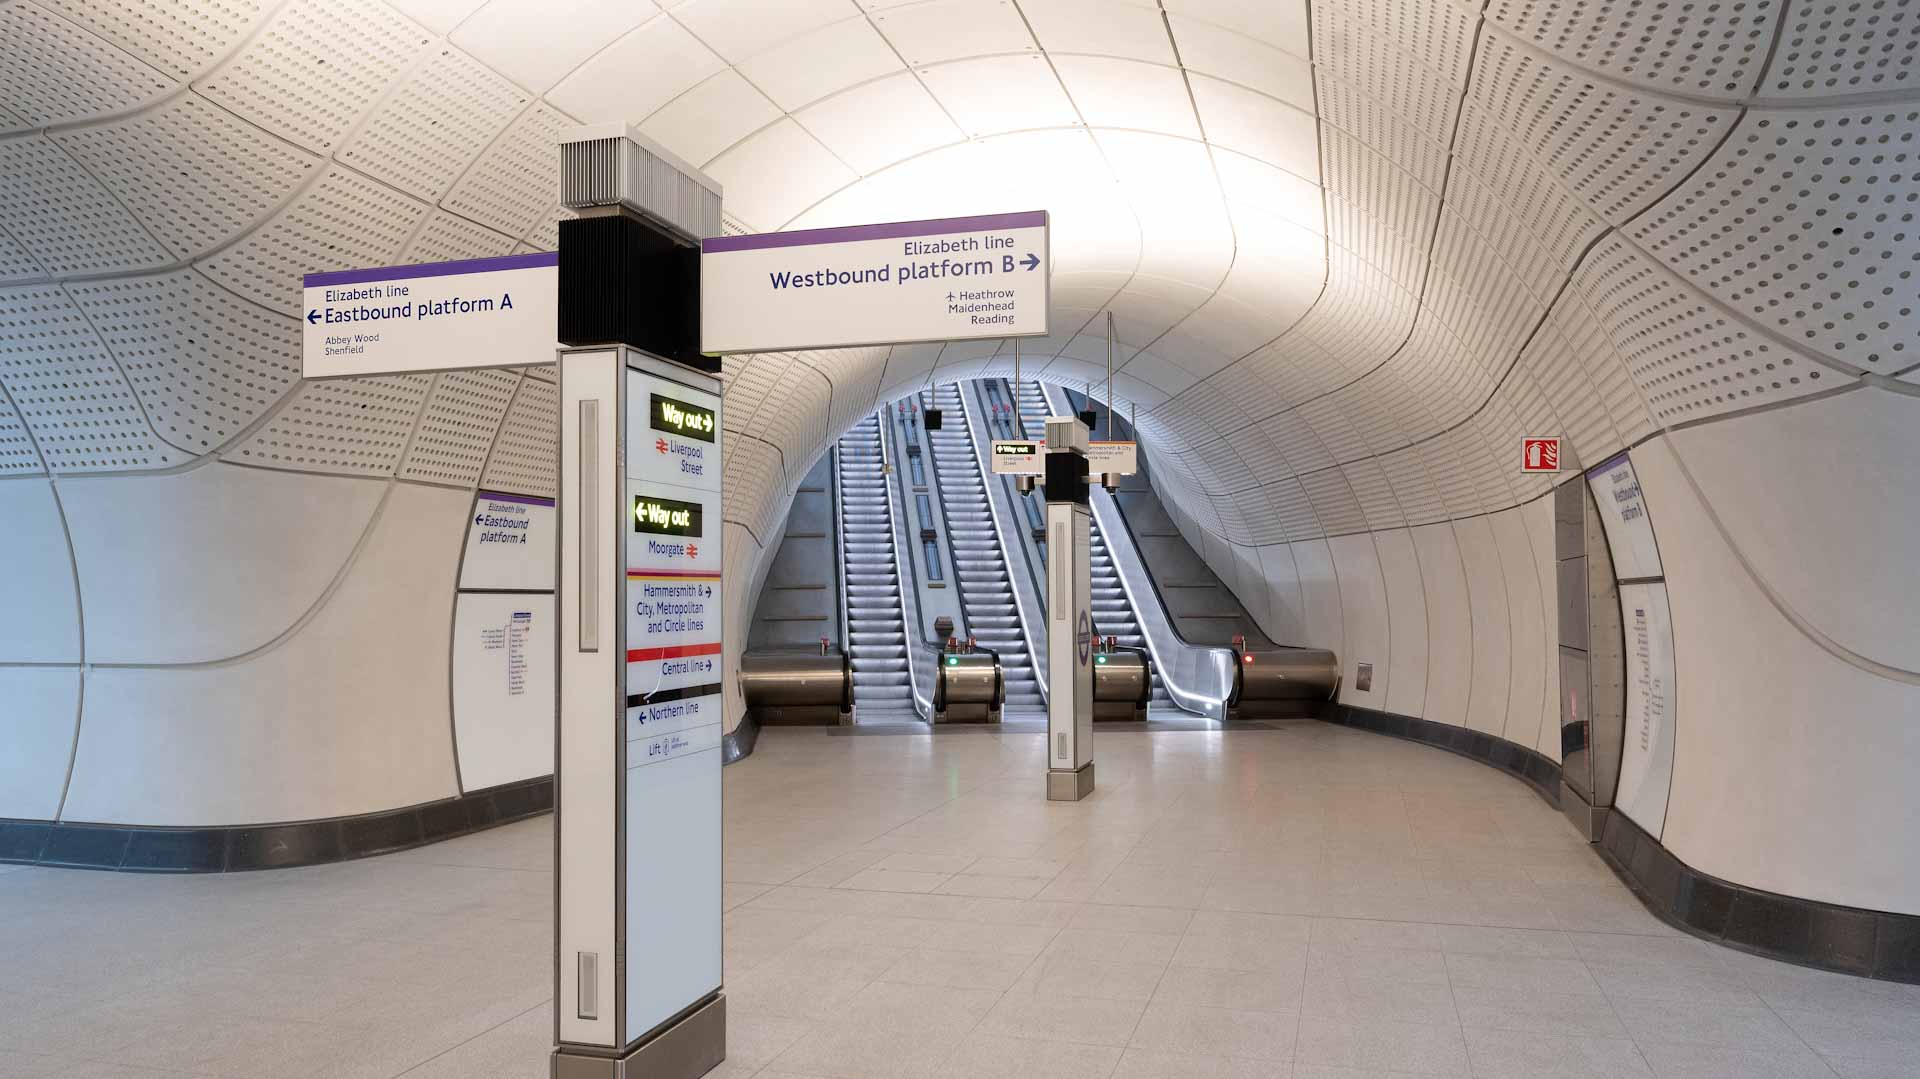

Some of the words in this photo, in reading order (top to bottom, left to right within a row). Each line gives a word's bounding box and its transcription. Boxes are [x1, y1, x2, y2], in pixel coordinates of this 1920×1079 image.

[904, 237, 980, 256] Elizabeth
[985, 235, 1015, 249] line
[769, 263, 890, 290] Westbound
[898, 257, 993, 285] platform
[1002, 254, 1015, 273] B
[325, 286, 382, 302] Elizabeth
[386, 284, 409, 298] line
[959, 288, 1015, 301] Heathrow
[325, 301, 412, 324] Eastbound
[418, 297, 494, 321] platform
[500, 293, 513, 310] A
[948, 300, 1015, 314] Maidenhead
[971, 313, 1015, 325] Reading
[325, 335, 352, 346] Abbey
[354, 333, 380, 343] Wood
[325, 345, 364, 356] Shenfield
[662, 402, 685, 430] Way
[685, 413, 703, 430] out
[670, 439, 703, 459] Liverpool
[1003, 445, 1016, 454] Way
[680, 459, 703, 476] Street
[488, 502, 515, 514] Elizabeth
[647, 503, 671, 529] Way
[671, 509, 690, 527] out
[484, 514, 530, 530] Eastbound
[479, 531, 519, 545] platform
[519, 533, 527, 544] A
[648, 540, 684, 558] Moorgate
[644, 583, 697, 598] Hammersmith
[697, 584, 704, 597] &
[636, 602, 655, 619] City,
[656, 602, 704, 617] Metropolitan
[647, 620, 663, 633] and
[664, 618, 686, 632] Circle
[687, 618, 704, 631] lines
[662, 661, 689, 676] Central
[690, 660, 704, 671] line
[649, 705, 684, 721] Northern
[685, 702, 699, 715] line
[649, 743, 661, 756] Lift
